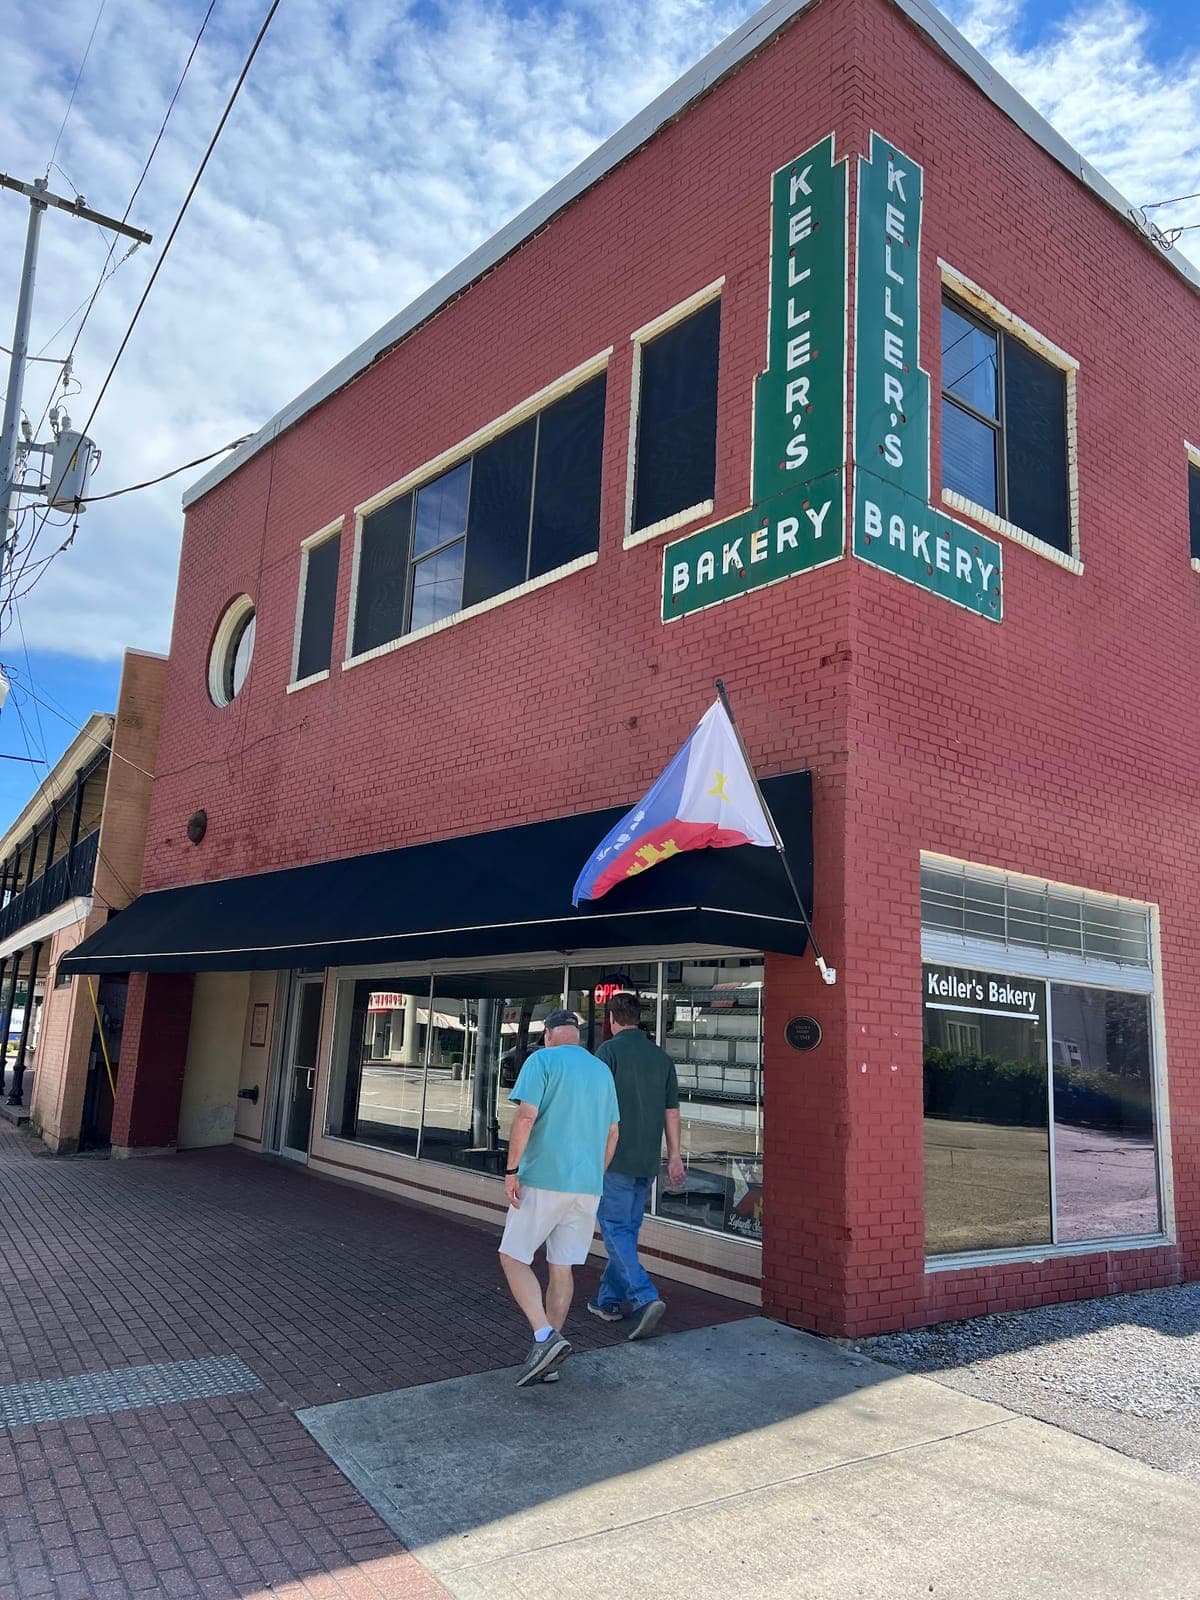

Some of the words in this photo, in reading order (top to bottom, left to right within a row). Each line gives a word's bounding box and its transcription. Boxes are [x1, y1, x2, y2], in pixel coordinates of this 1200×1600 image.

[785, 164, 814, 470] KELLER'S
[884, 160, 908, 469] KELLER'S
[672, 500, 832, 595] BAKERY
[864, 500, 994, 592] BAKERY
[928, 972, 984, 1001] Keller's
[989, 981, 1036, 1012] Bakery
